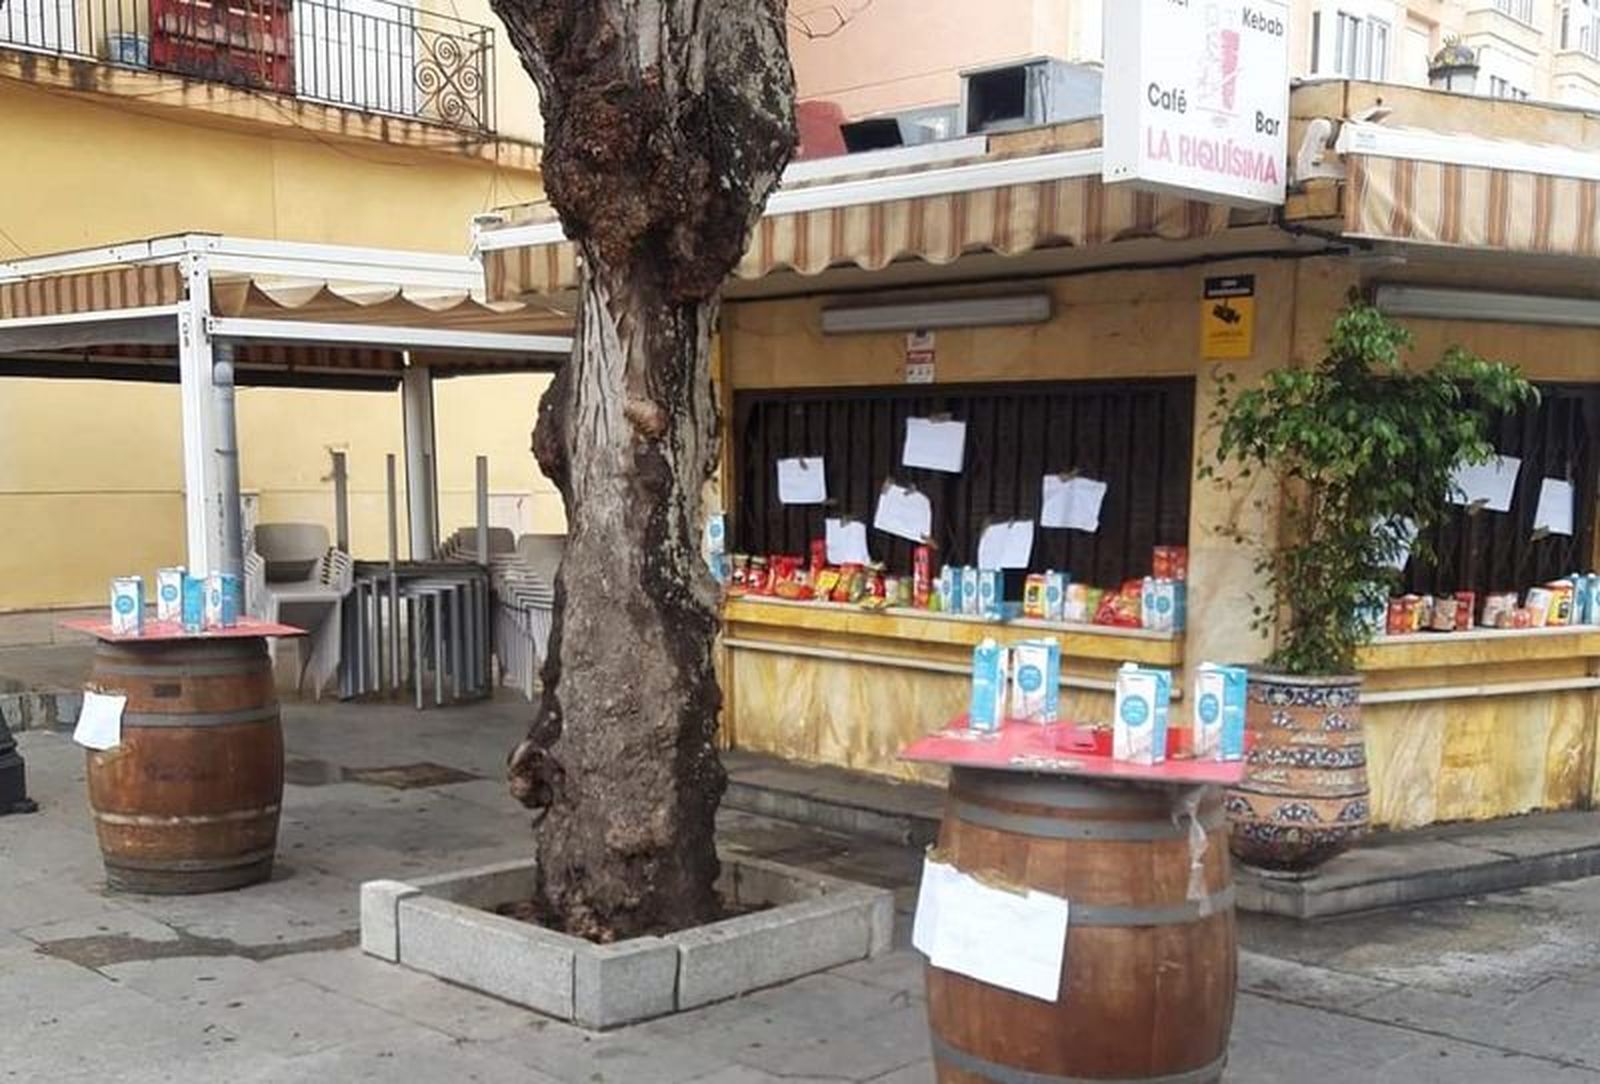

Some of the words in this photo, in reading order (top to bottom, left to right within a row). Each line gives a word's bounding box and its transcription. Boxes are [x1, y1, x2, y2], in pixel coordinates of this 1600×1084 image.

[1242, 8, 1284, 37] Kebab
[1147, 82, 1187, 114] Café
[1255, 110, 1280, 137] Bar
[1147, 126, 1172, 162] LA
[1179, 133, 1278, 185] RIQUÍSIMA
